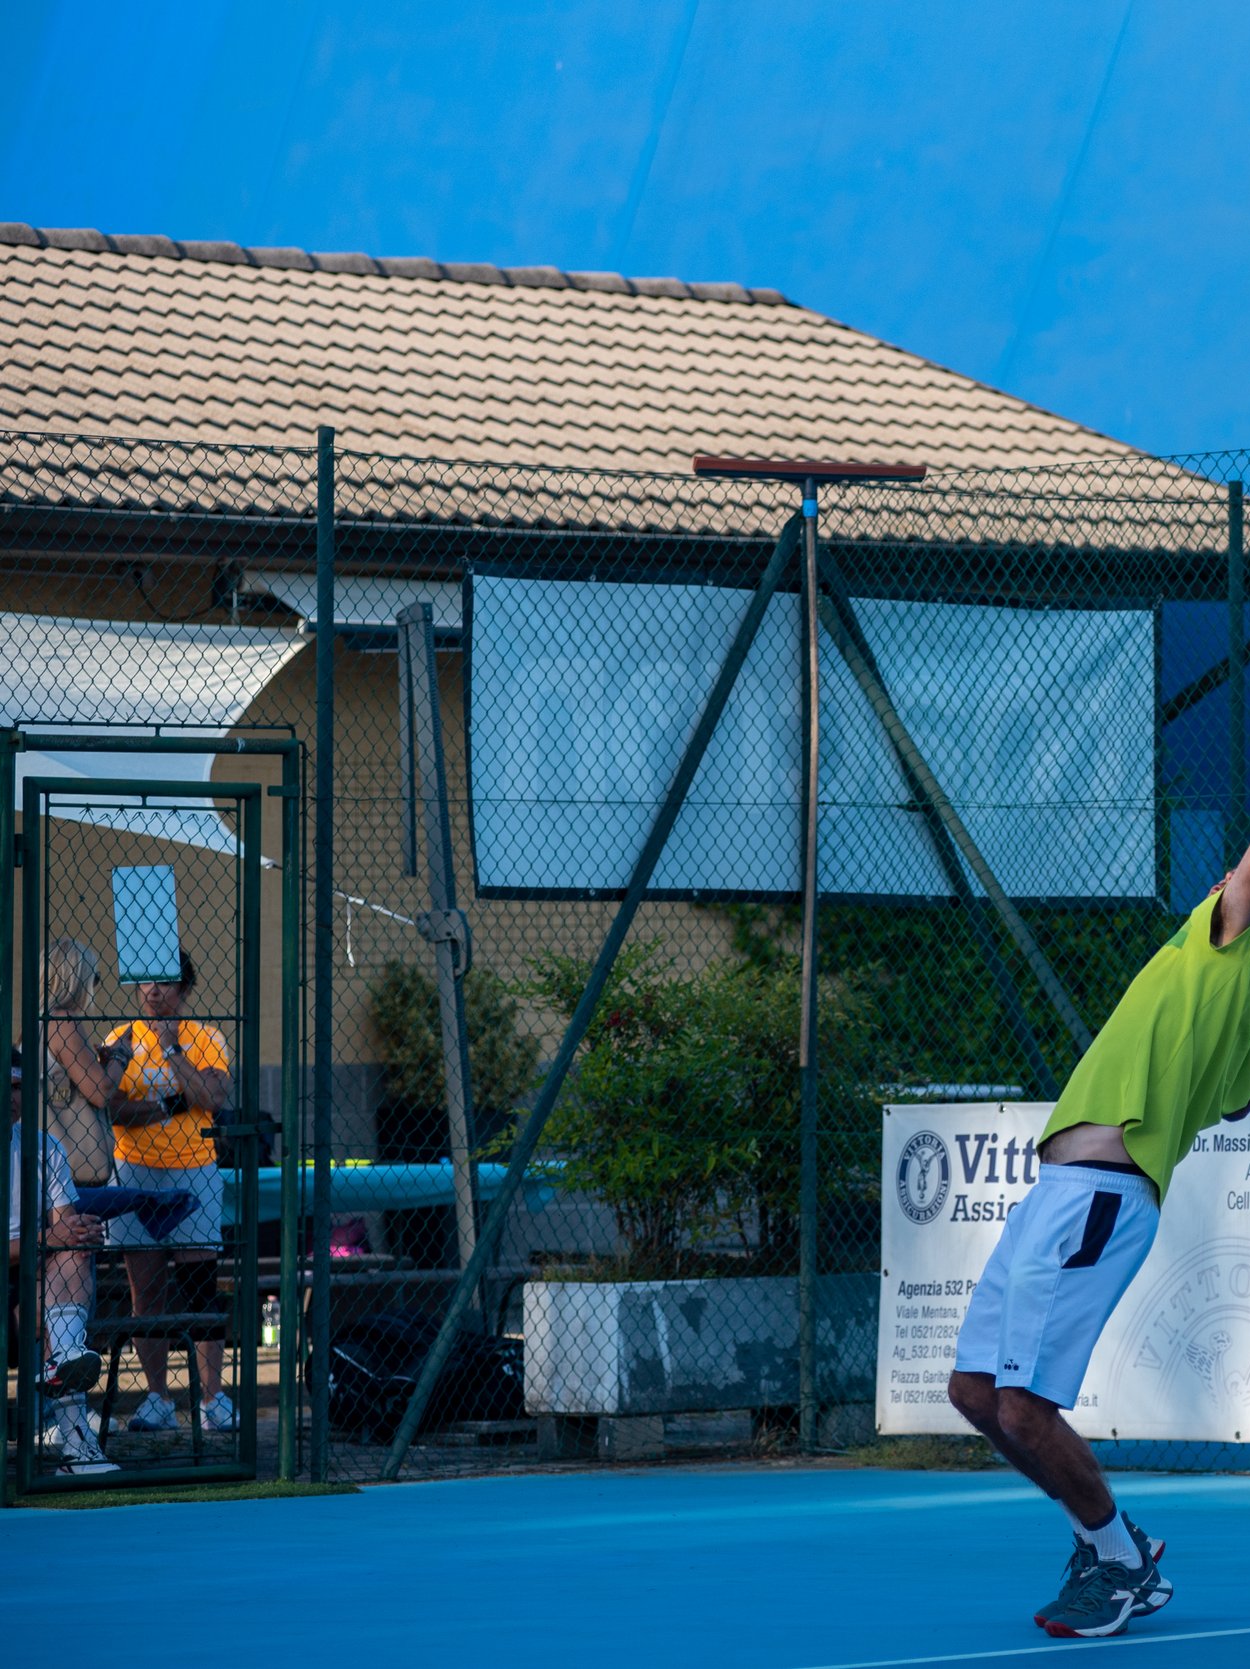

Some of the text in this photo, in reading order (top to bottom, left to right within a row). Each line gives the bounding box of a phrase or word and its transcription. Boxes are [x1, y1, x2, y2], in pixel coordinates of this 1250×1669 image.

[1193, 1135, 1209, 1152] Dr.
[955, 1133, 1037, 1184] Vitt
[898, 1280, 942, 1300] Agenzia
[945, 1280, 963, 1296] 532
[896, 1305, 919, 1319] Viale
[895, 1325, 959, 1339] Tel 0521/2824
[892, 1344, 956, 1361] Ag_532.01@a
